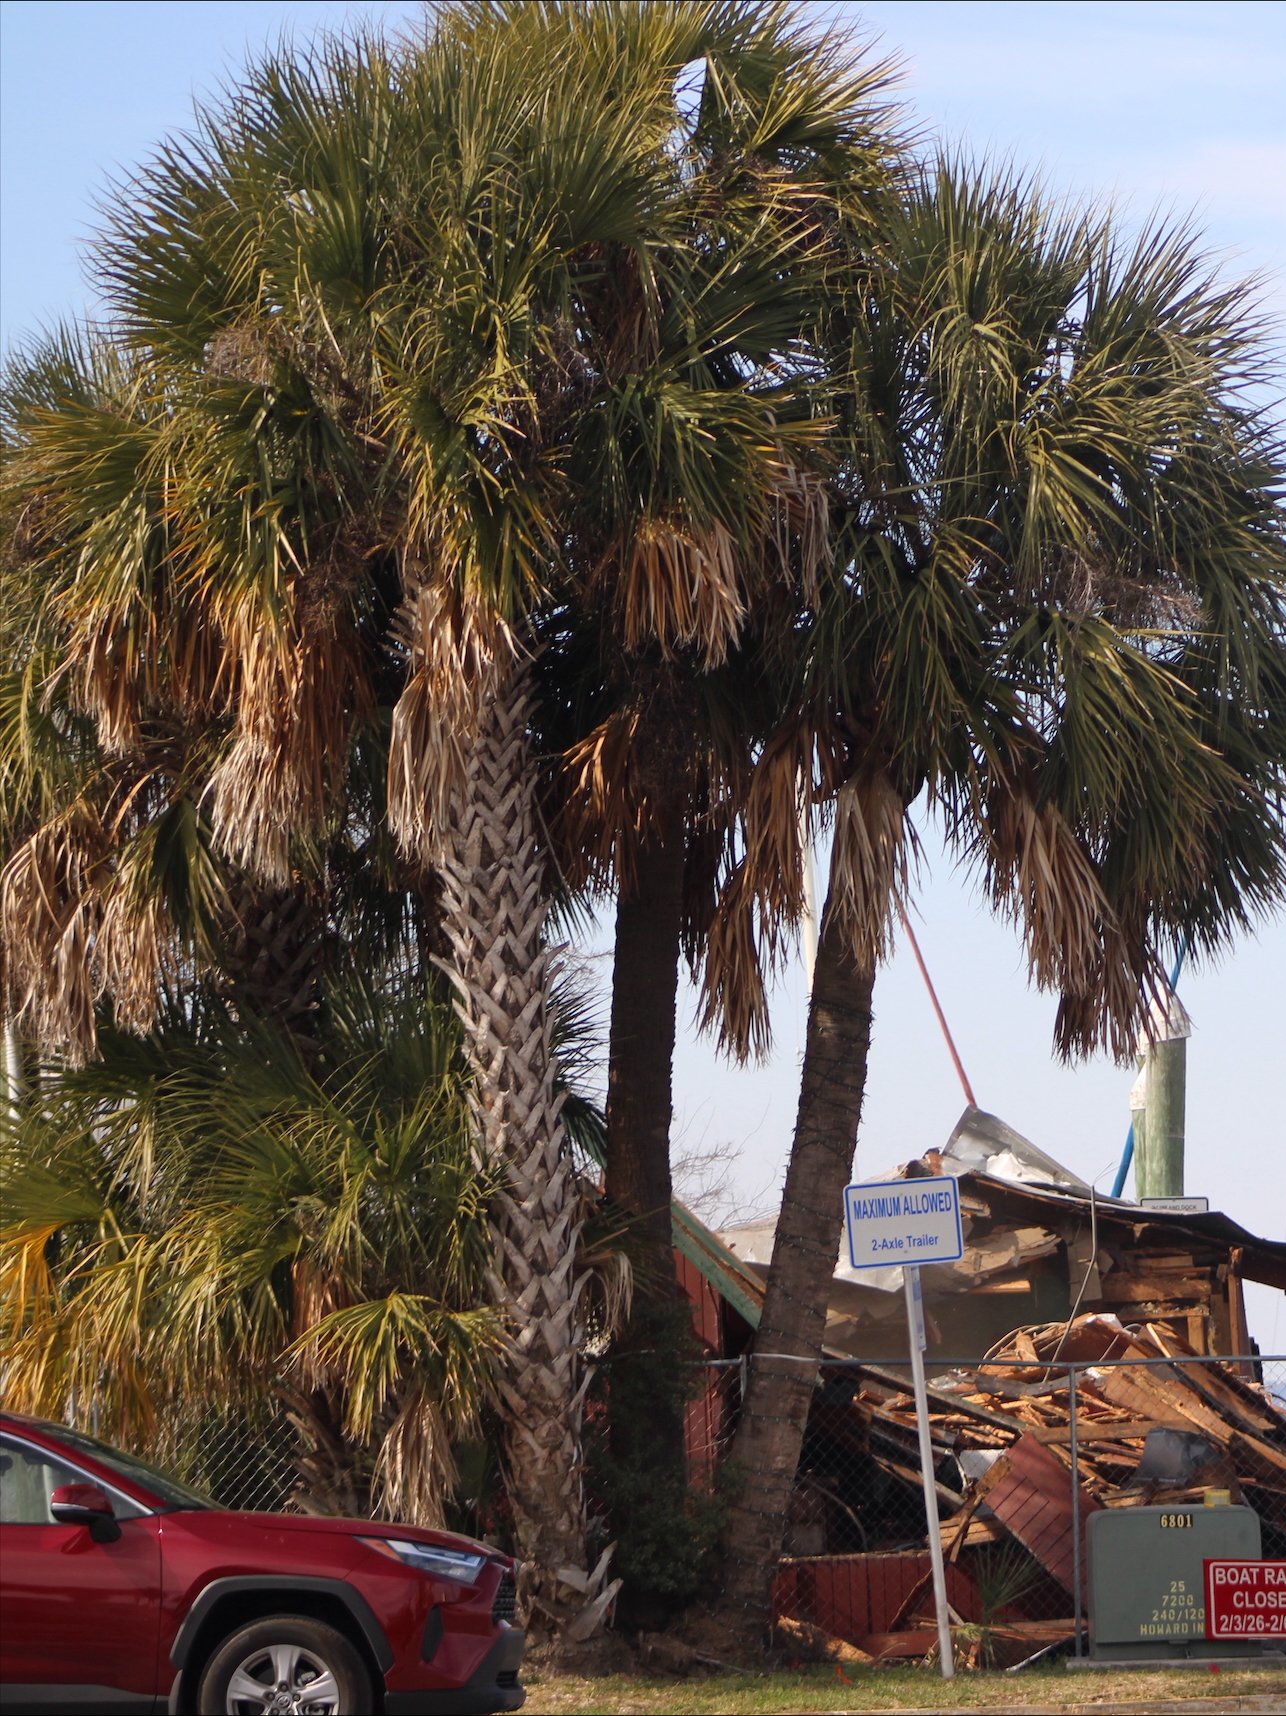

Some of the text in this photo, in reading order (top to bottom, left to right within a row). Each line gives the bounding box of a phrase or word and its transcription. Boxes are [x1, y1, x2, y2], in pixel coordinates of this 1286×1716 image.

[854, 1191, 952, 1220] MAXIMUM ALLOWED
[872, 1234, 938, 1251] 2-Axle Trailer
[1160, 1514, 1192, 1528] 6801
[1215, 1567, 1260, 1585] BOAT
[1170, 1580, 1186, 1592] 25
[1162, 1595, 1194, 1606] 7200
[1152, 1608, 1205, 1621] 240/120
[1140, 1622, 1189, 1635] HOWARD
